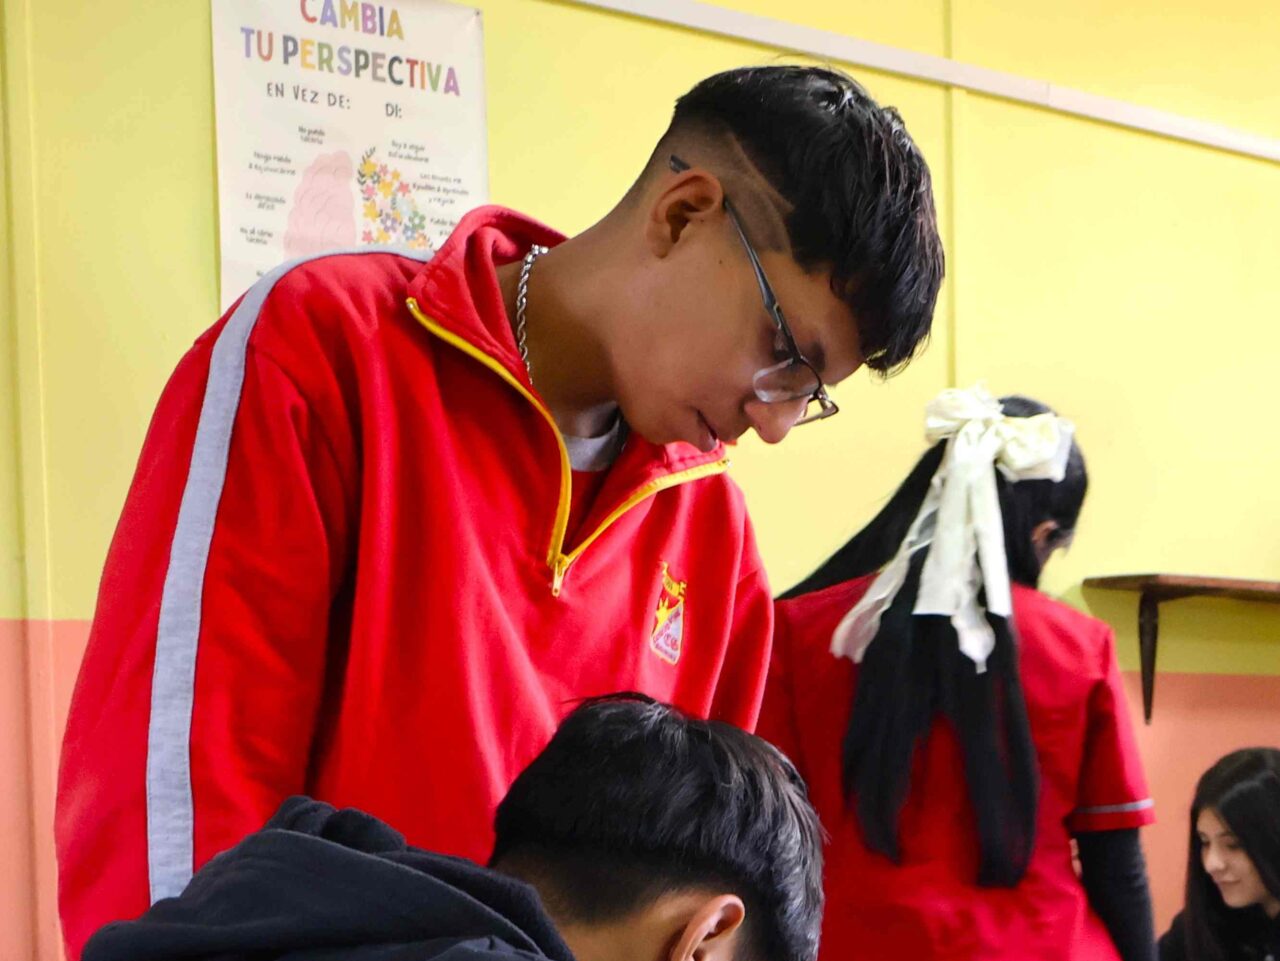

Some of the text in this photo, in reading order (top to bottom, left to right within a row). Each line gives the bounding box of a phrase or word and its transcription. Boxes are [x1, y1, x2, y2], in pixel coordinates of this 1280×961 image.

[300, 0, 404, 40] CAMBIA
[240, 27, 460, 97] TU PERSPECTIVA
[267, 82, 350, 110] EN VEZ DE:
